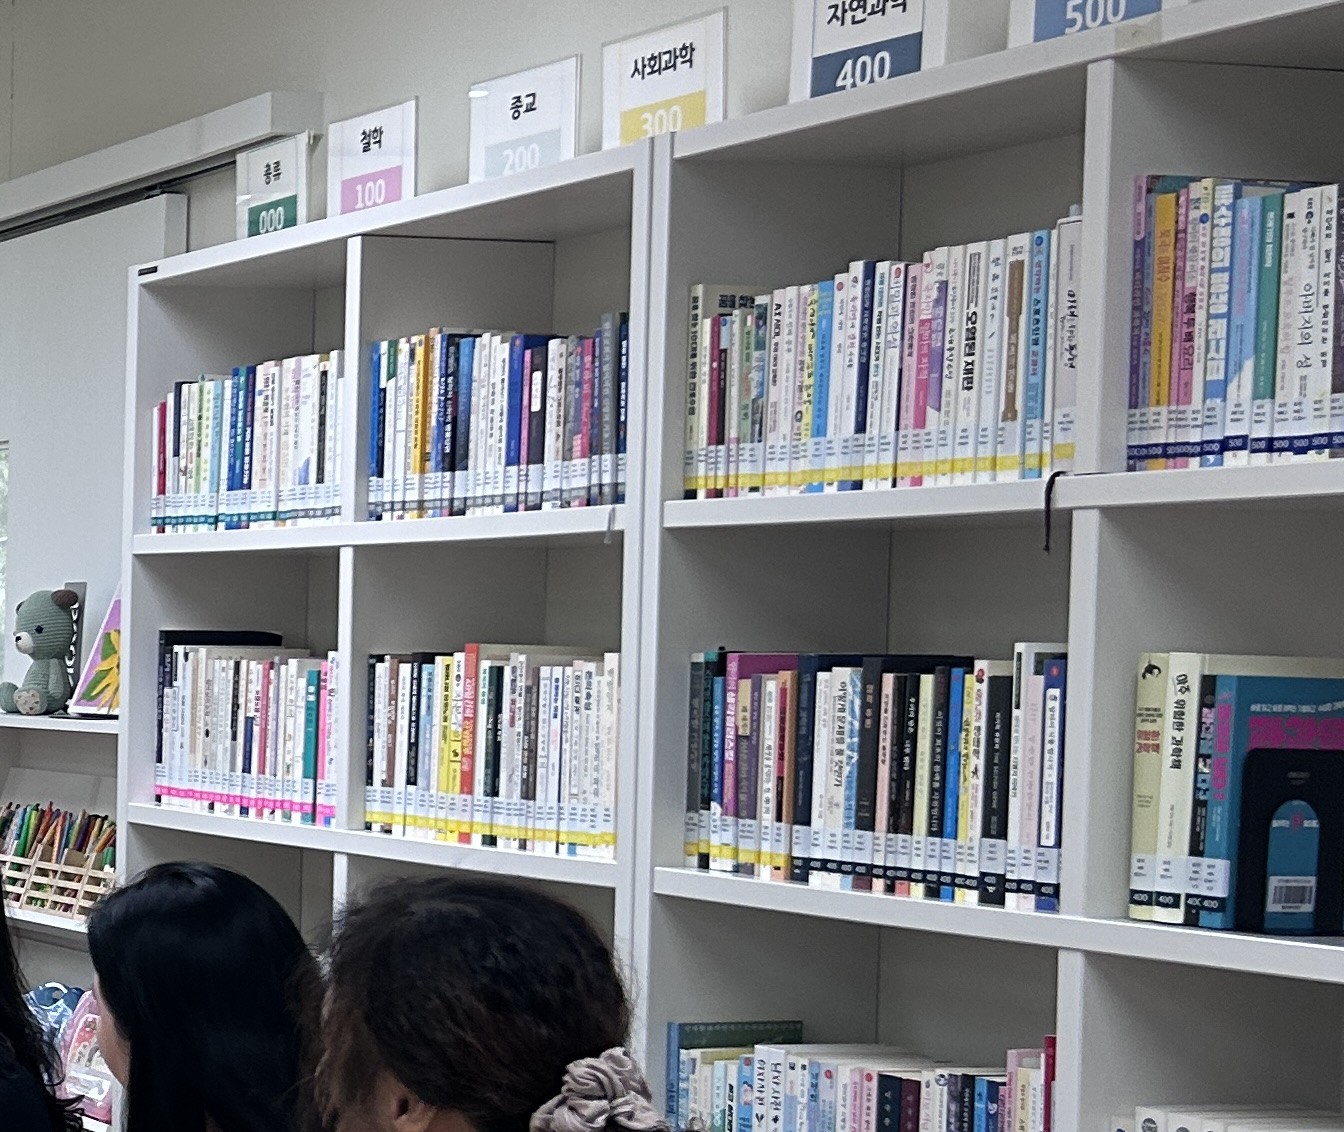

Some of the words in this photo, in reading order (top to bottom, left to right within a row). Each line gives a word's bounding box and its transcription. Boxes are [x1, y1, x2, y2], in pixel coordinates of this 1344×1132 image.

[1064, 0, 1127, 35] 500
[630, 43, 695, 80] 사회과학
[835, 51, 891, 90] 400
[510, 93, 537, 120] 종교
[640, 105, 683, 138] 300
[360, 126, 384, 153] 철학
[502, 145, 540, 176] 200
[354, 178, 386, 210] 100
[259, 206, 284, 233] 000
[1297, 284, 1314, 345] 아버지의
[962, 361, 974, 391] 재판
[1172, 699, 1186, 732] 위험한
[1170, 736, 1184, 769] 과학책
